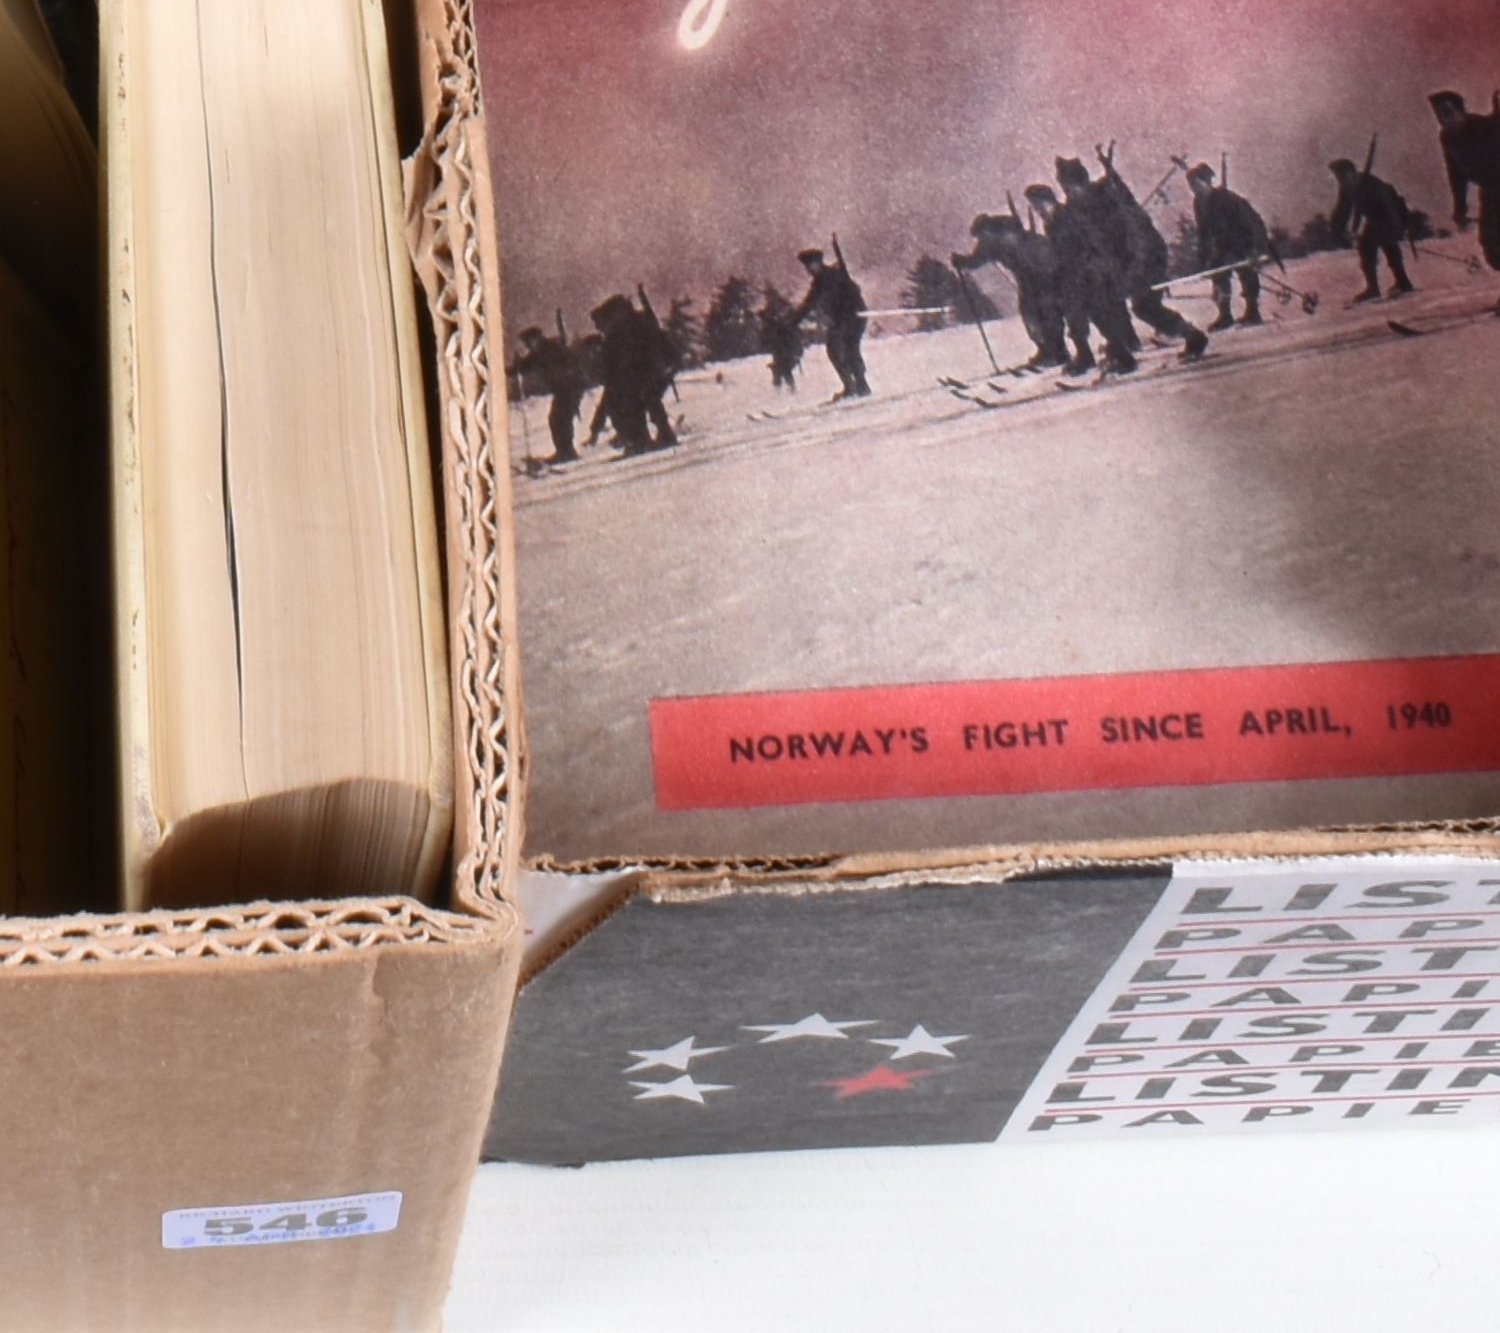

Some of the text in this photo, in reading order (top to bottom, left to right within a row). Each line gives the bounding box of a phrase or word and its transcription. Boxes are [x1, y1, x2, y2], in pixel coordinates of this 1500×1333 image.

[729, 701, 1453, 764] NORWAY'S FIGHT SINCE APRIL, 1940
[203, 1206, 369, 1237] 546
